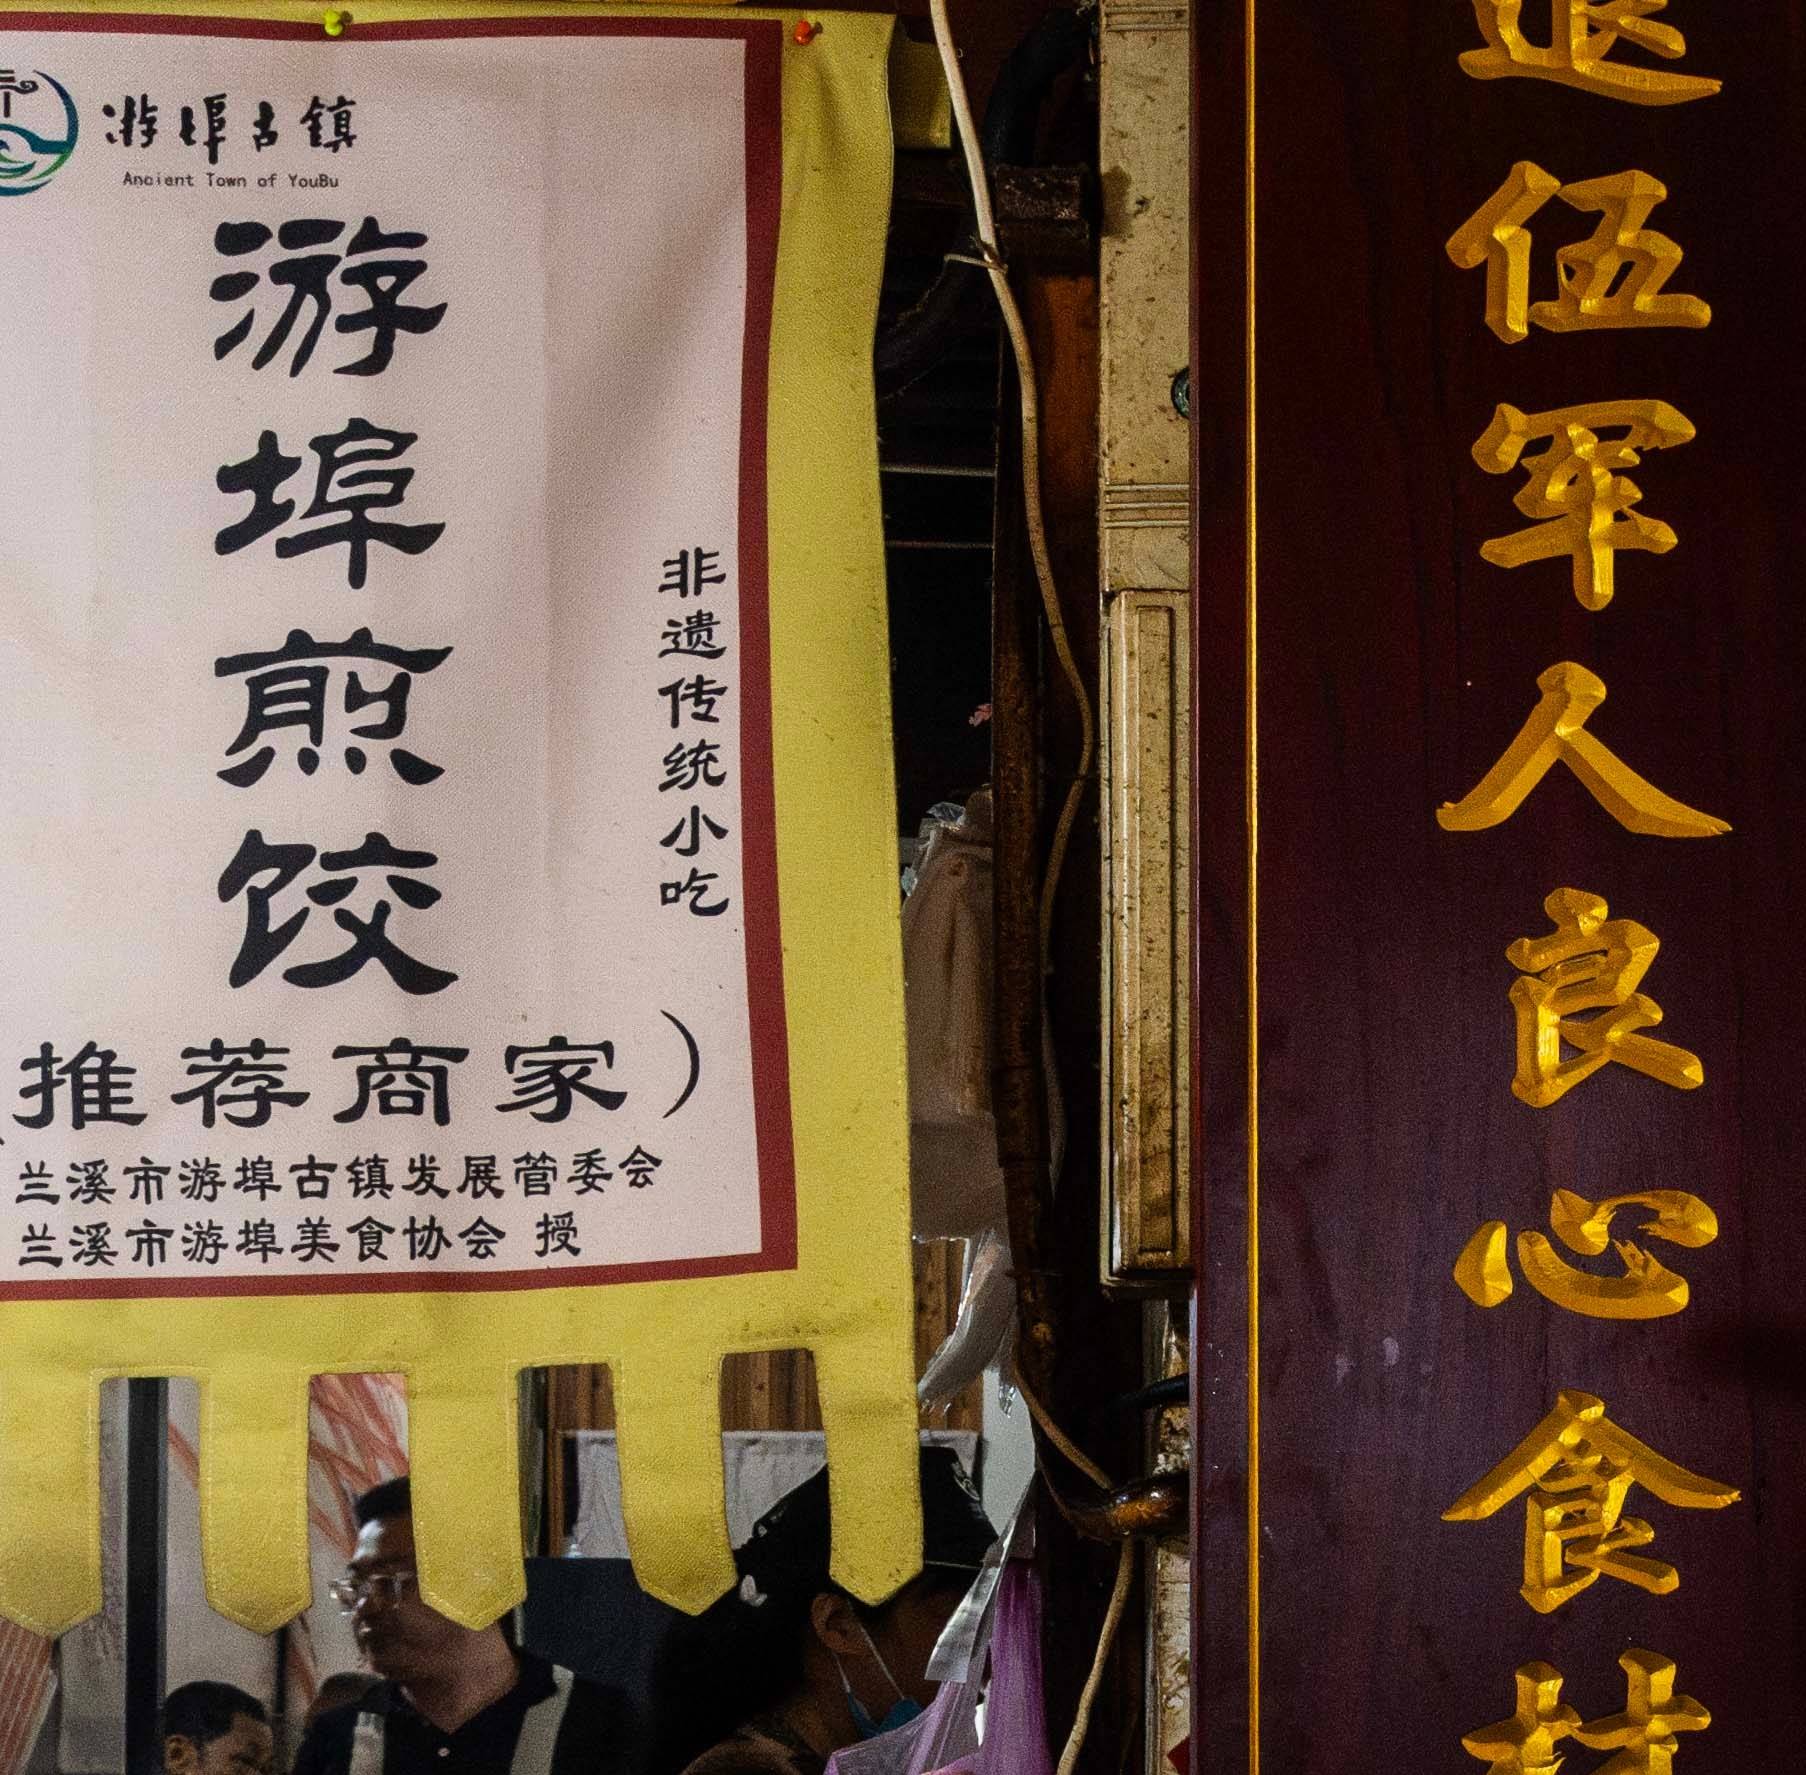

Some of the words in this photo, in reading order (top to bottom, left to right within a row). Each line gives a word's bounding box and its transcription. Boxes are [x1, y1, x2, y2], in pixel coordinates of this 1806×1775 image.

[122, 171, 195, 187] Ancient
[207, 172, 247, 188] Town
[257, 172, 278, 188] of
[288, 173, 340, 188] YouBu
[210, 216, 459, 994] 游埠煎饺
[657, 547, 730, 917] 非遗传统小吃
[15, 1144, 663, 1206] 兰溪市游埠古镇发展管委会
[18, 1215, 506, 1268] 兰溪市游埠美食协会
[534, 1211, 582, 1258] 授
